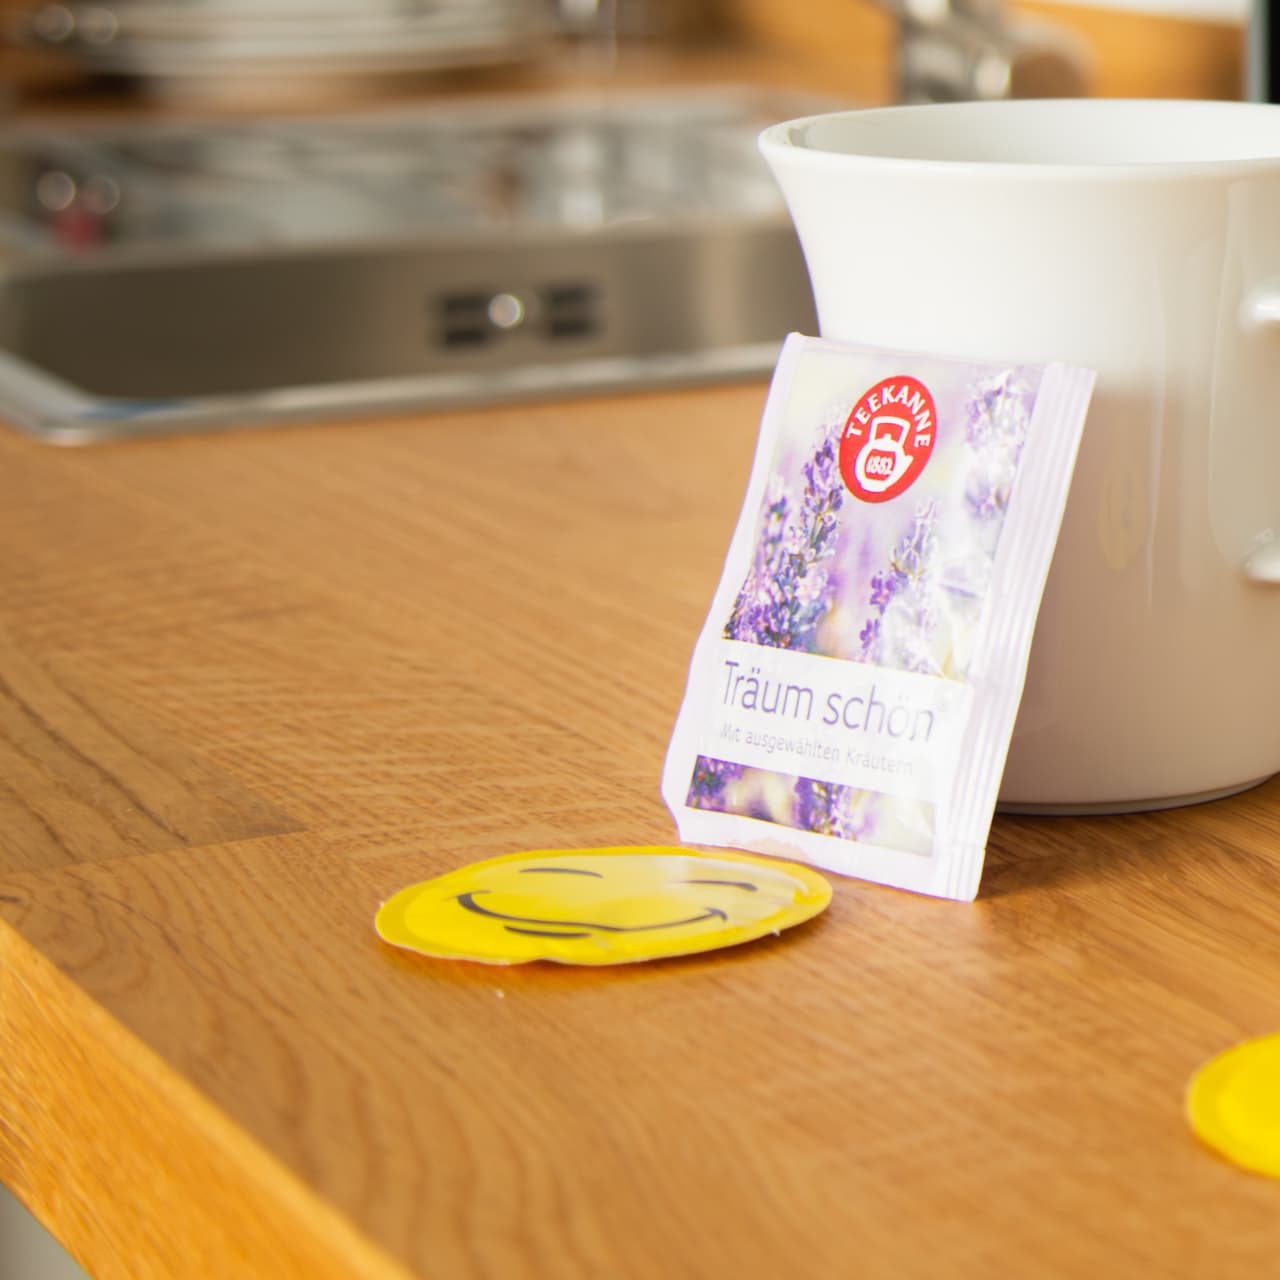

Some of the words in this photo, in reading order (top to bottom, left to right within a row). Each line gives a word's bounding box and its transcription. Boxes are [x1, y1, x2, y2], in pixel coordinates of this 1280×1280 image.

[845, 384, 932, 448] TEEKANNE
[865, 455, 894, 476] 1882
[723, 660, 813, 721] Träum
[822, 683, 935, 742] schön
[720, 722, 742, 743] Mit
[744, 729, 841, 762] ausgewählten
[846, 745, 914, 776] Kräutern
